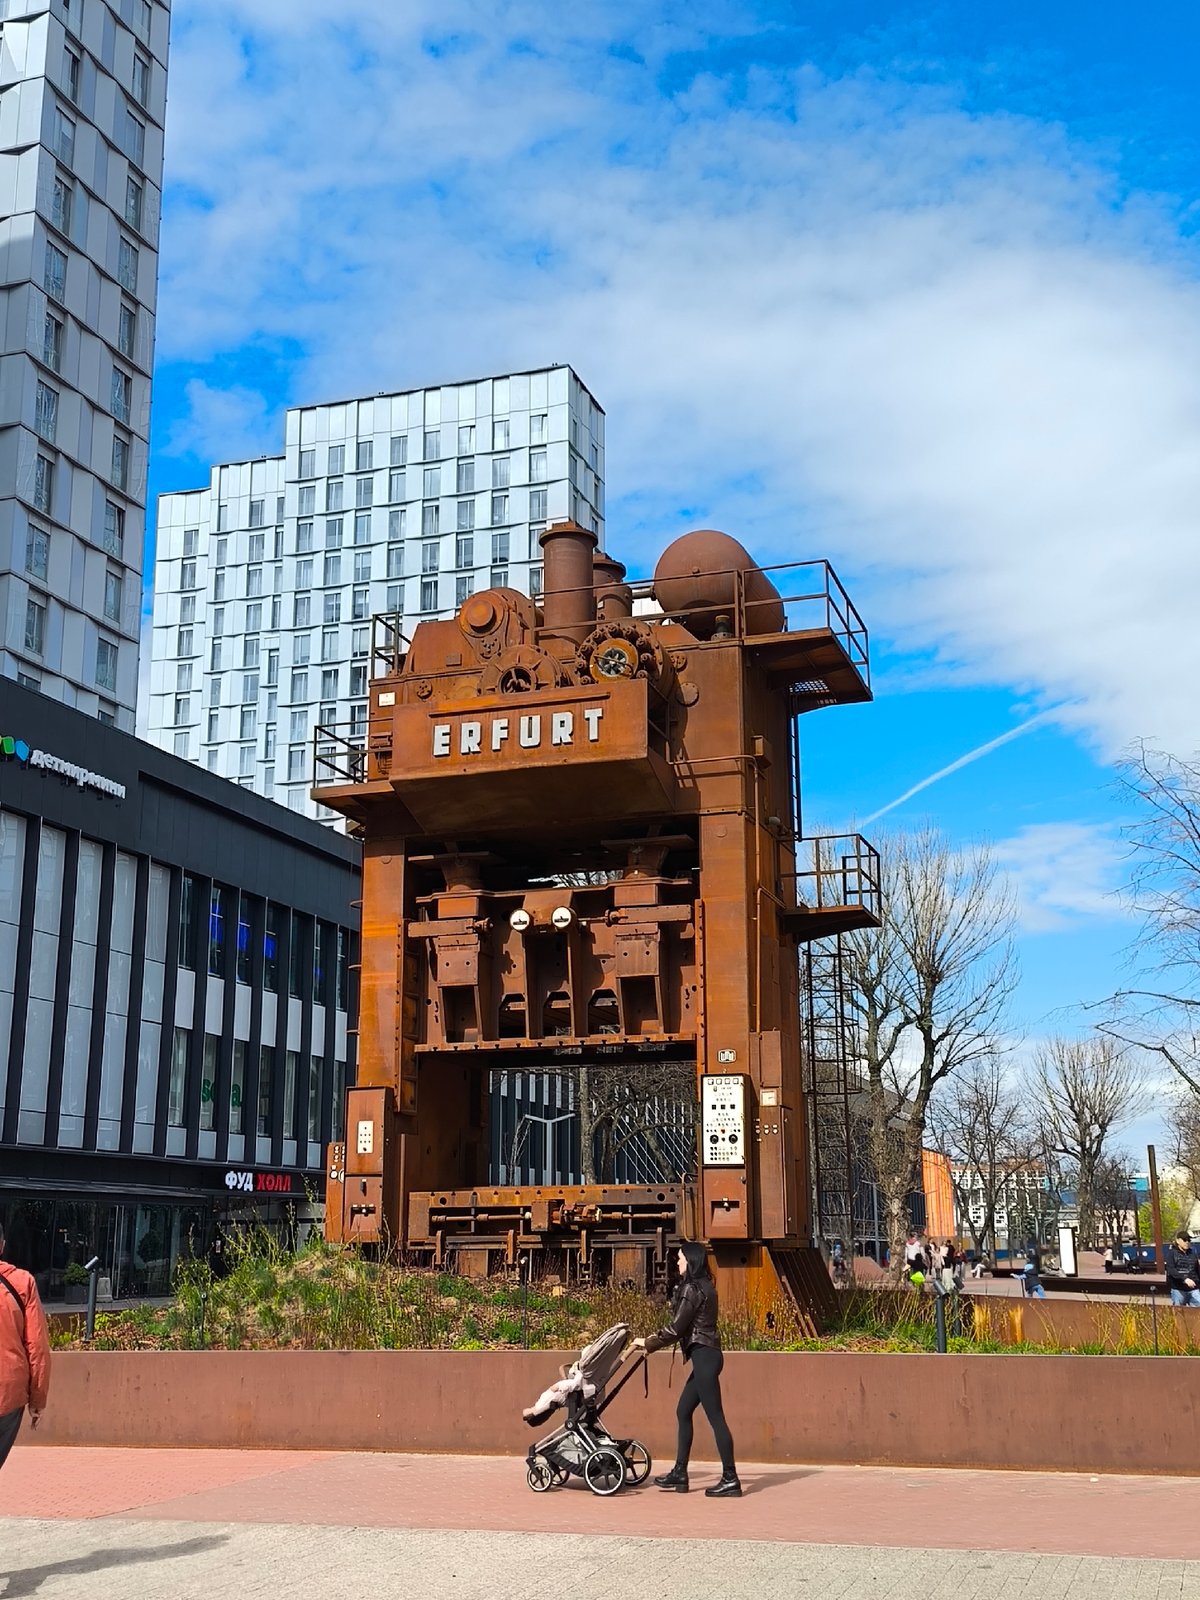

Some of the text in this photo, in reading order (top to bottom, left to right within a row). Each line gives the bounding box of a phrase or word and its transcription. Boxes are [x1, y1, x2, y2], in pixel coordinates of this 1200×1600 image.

[433, 708, 602, 756] ERFURT
[225, 1170, 292, 1192] ФУД ХОЛЛ
